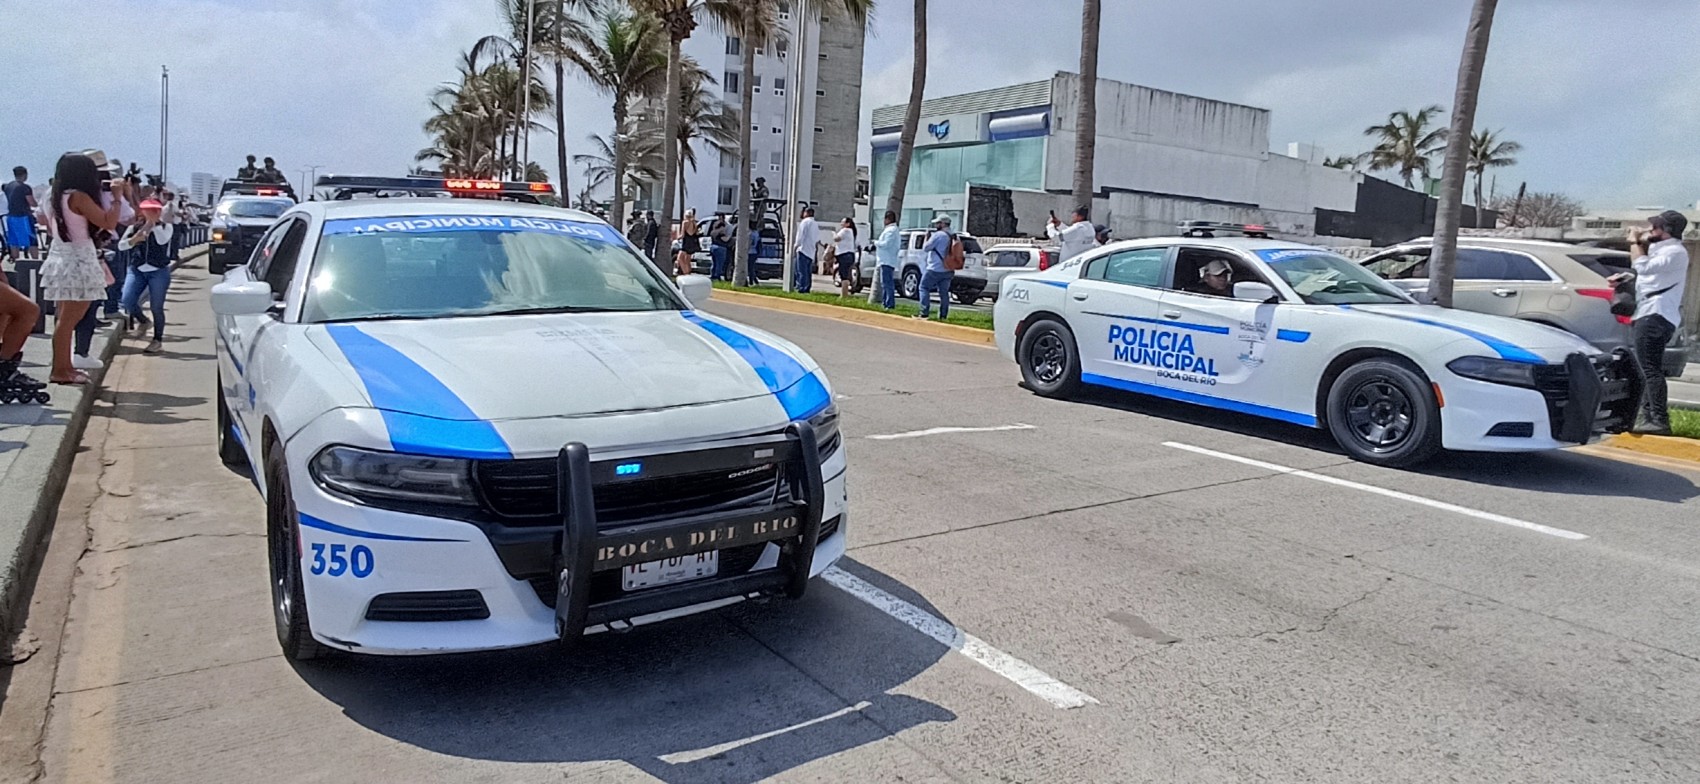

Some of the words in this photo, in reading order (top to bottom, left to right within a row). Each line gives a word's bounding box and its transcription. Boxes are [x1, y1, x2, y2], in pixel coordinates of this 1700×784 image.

[1108, 324, 1195, 355] POLICIA
[1114, 345, 1219, 376] MUNICIPAL
[1157, 370, 1180, 380] BOCA
[1182, 374, 1199, 383] DEL
[728, 464, 771, 478] DODGE
[598, 537, 675, 561] BOCA
[691, 527, 738, 546] DEL
[754, 516, 797, 535] RIO
[310, 543, 375, 578] 350
